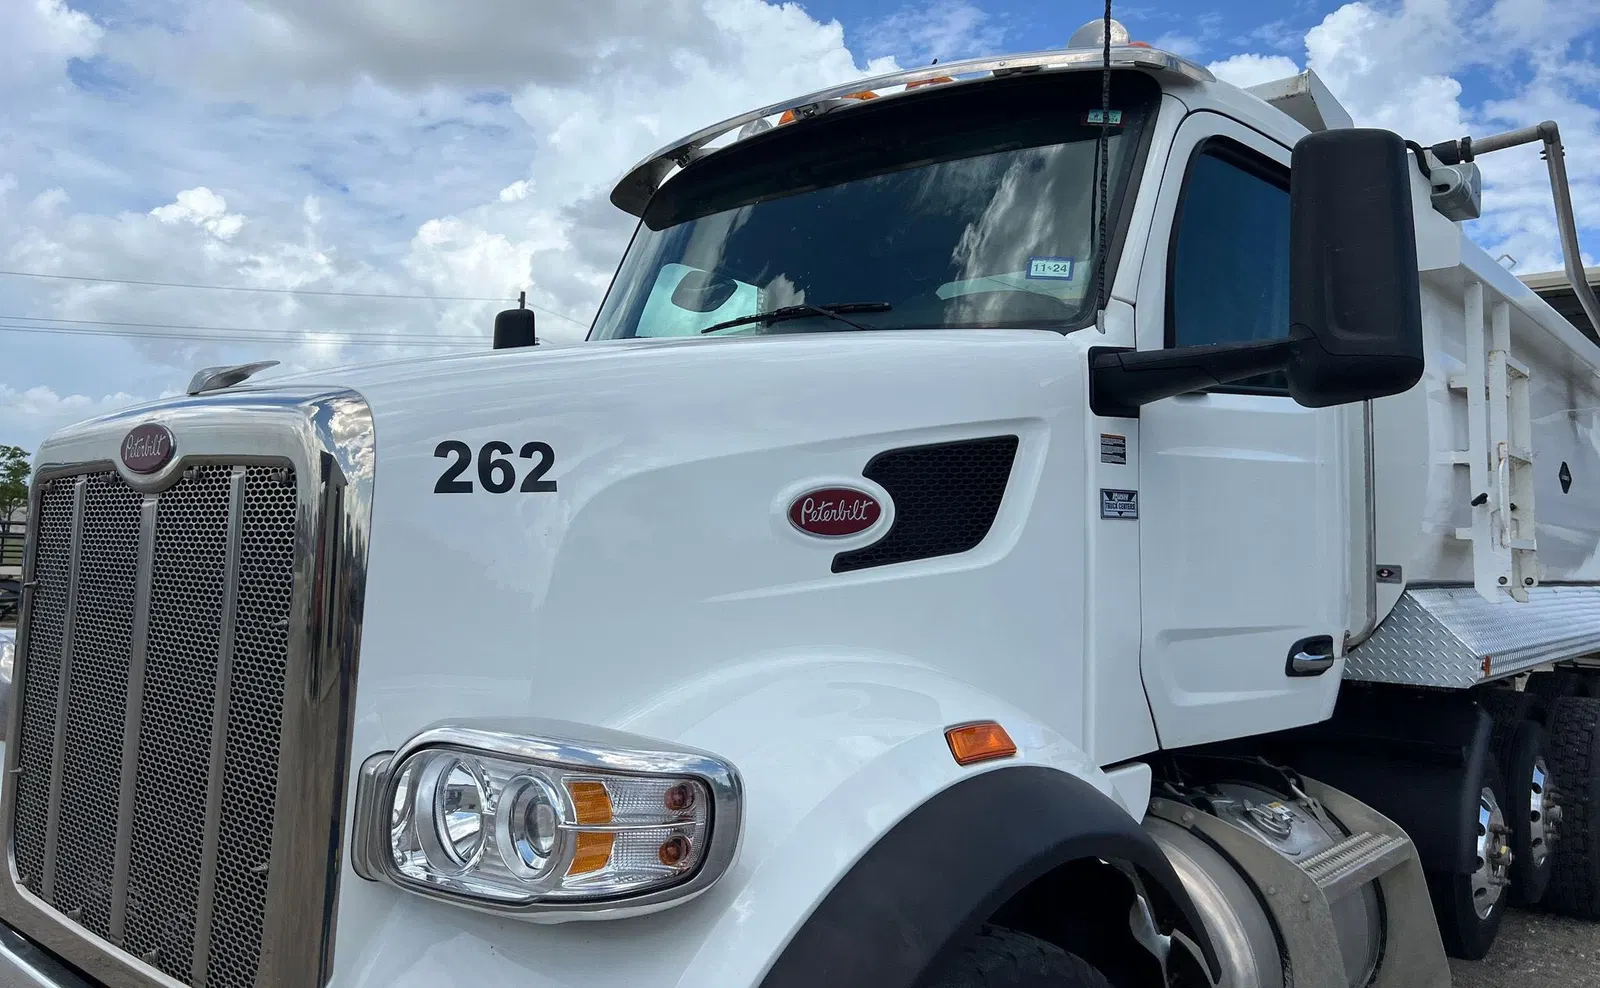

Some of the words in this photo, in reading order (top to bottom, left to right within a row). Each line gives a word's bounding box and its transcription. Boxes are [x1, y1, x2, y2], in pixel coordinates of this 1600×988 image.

[124, 434, 166, 460] Peterbilt
[433, 440, 558, 494] 262
[801, 497, 874, 525] Peterbilt
